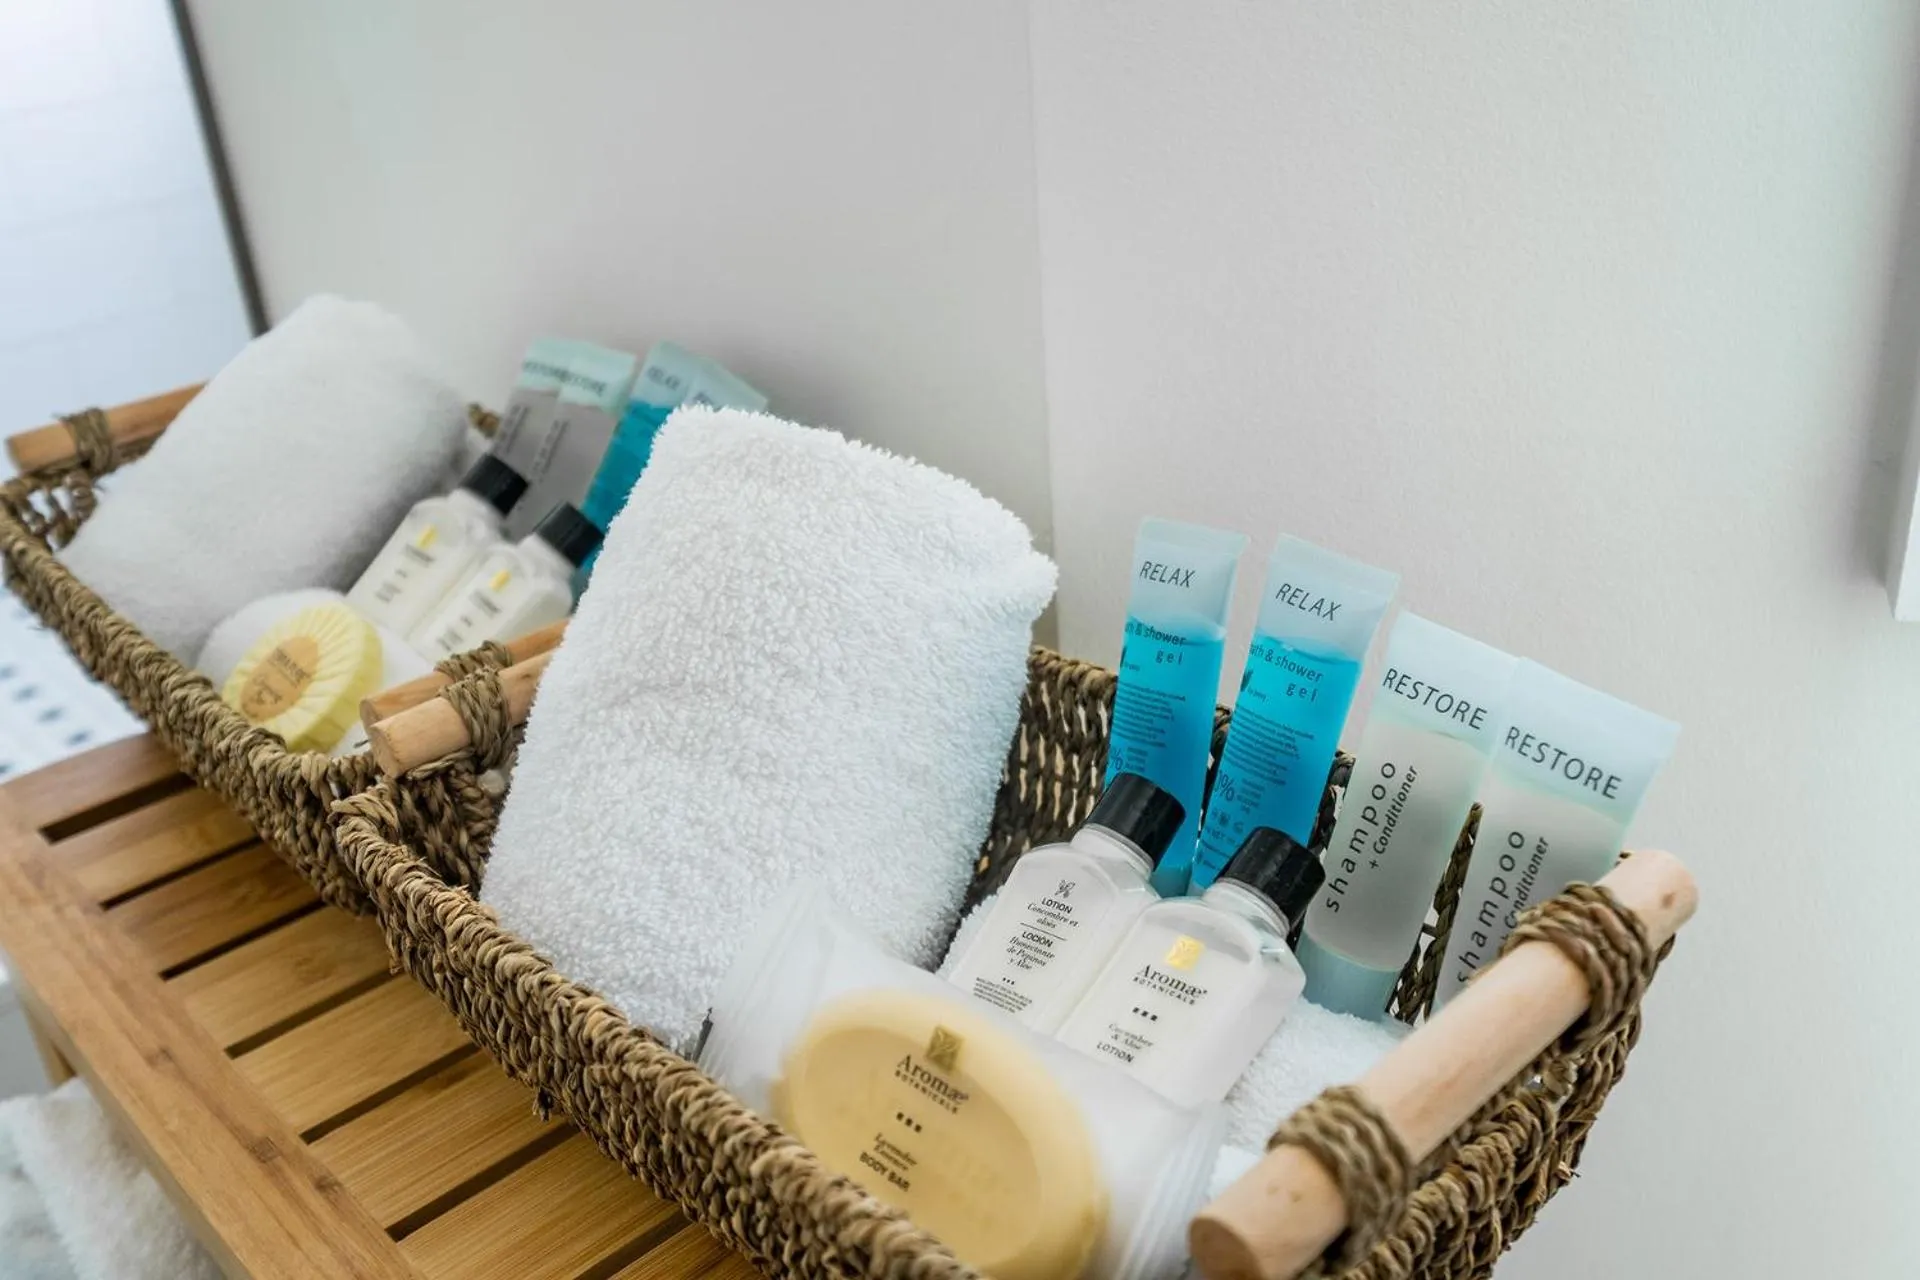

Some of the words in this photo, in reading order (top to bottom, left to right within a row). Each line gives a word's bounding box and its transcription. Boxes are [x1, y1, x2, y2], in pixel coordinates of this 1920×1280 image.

[1140, 561, 1195, 588] RELAX
[1275, 583, 1341, 621] RELAX
[1144, 626, 1187, 647] shower
[1155, 649, 1184, 666] gel
[1265, 648, 1275, 663] &
[1275, 656, 1324, 683] shower
[1286, 683, 1318, 703] gel
[1382, 667, 1488, 731] RESTORE
[1504, 726, 1622, 800] RESTORE
[1373, 765, 1419, 855] Conditioner
[1326, 762, 1396, 913] shampoo
[1369, 859, 1380, 870] +
[1042, 897, 1073, 914] LOTION
[1457, 831, 1525, 983] shampoo
[1096, 1041, 1135, 1063] LOTION
[859, 1151, 888, 1176] BODY
[887, 1170, 911, 1193] BAR
